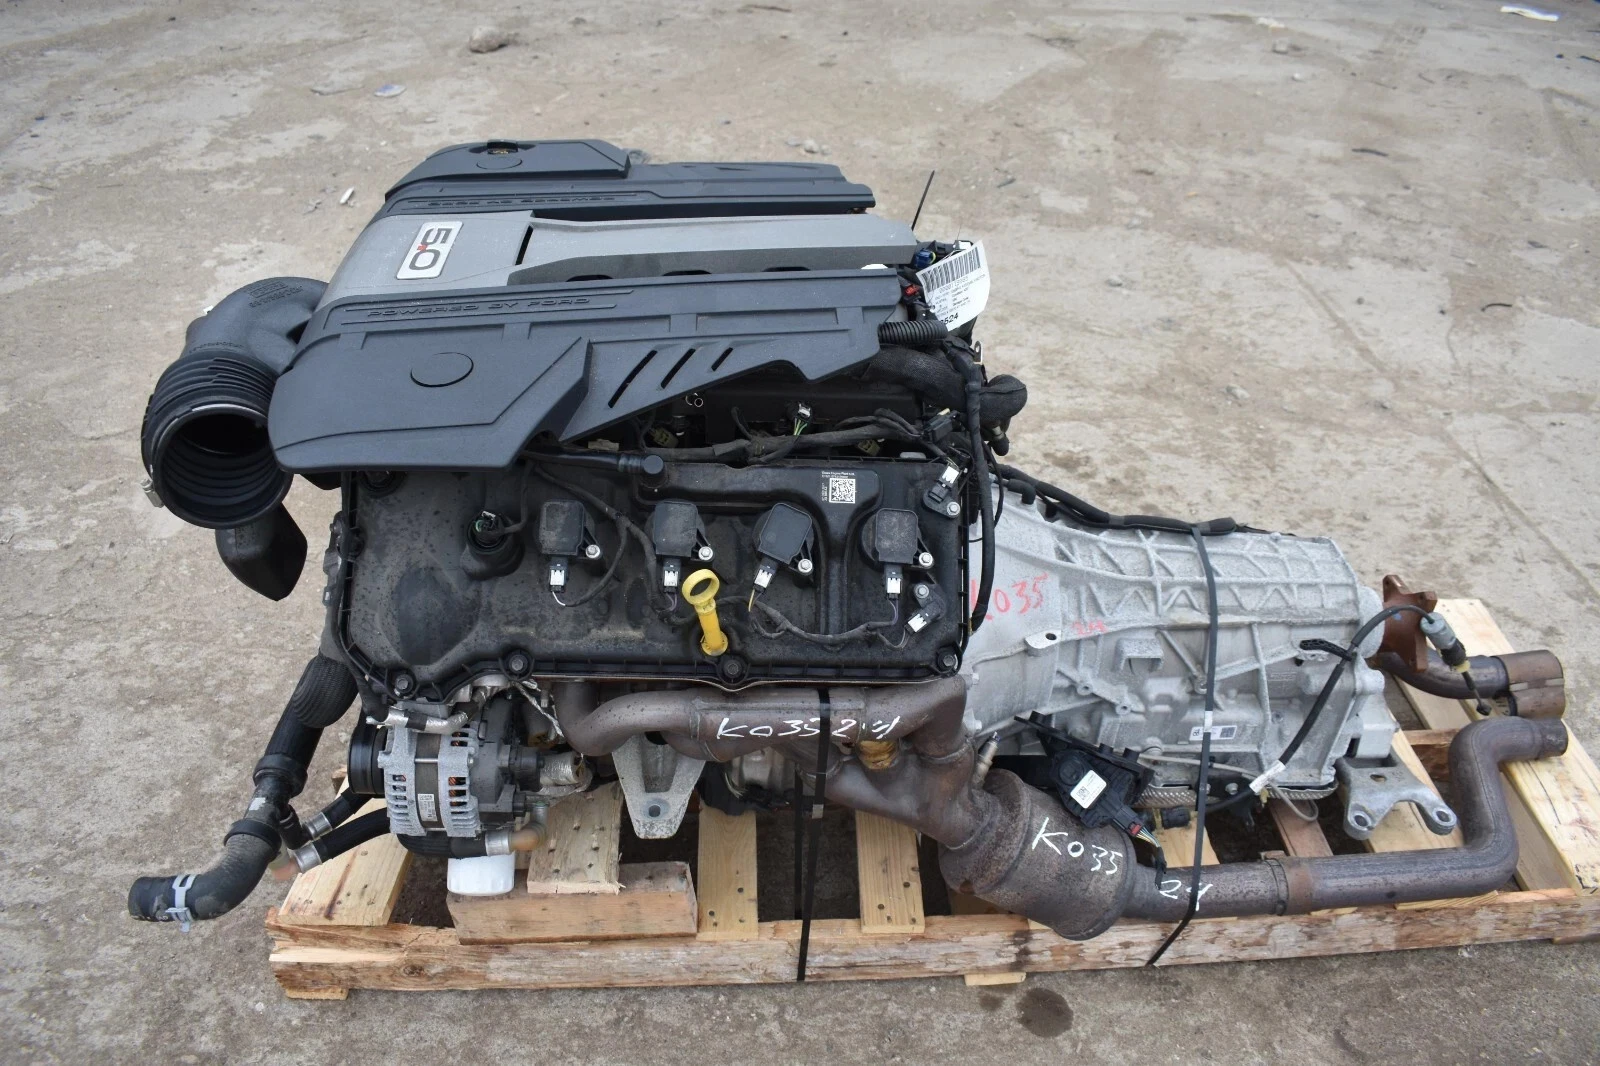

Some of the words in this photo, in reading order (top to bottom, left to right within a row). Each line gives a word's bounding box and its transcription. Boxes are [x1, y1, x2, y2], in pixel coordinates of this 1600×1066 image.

[408, 228, 453, 271] 5.0
[367, 304, 480, 318] POWERED
[488, 302, 519, 310] BY
[527, 298, 590, 308] FORD
[1031, 816, 1124, 876] K035
